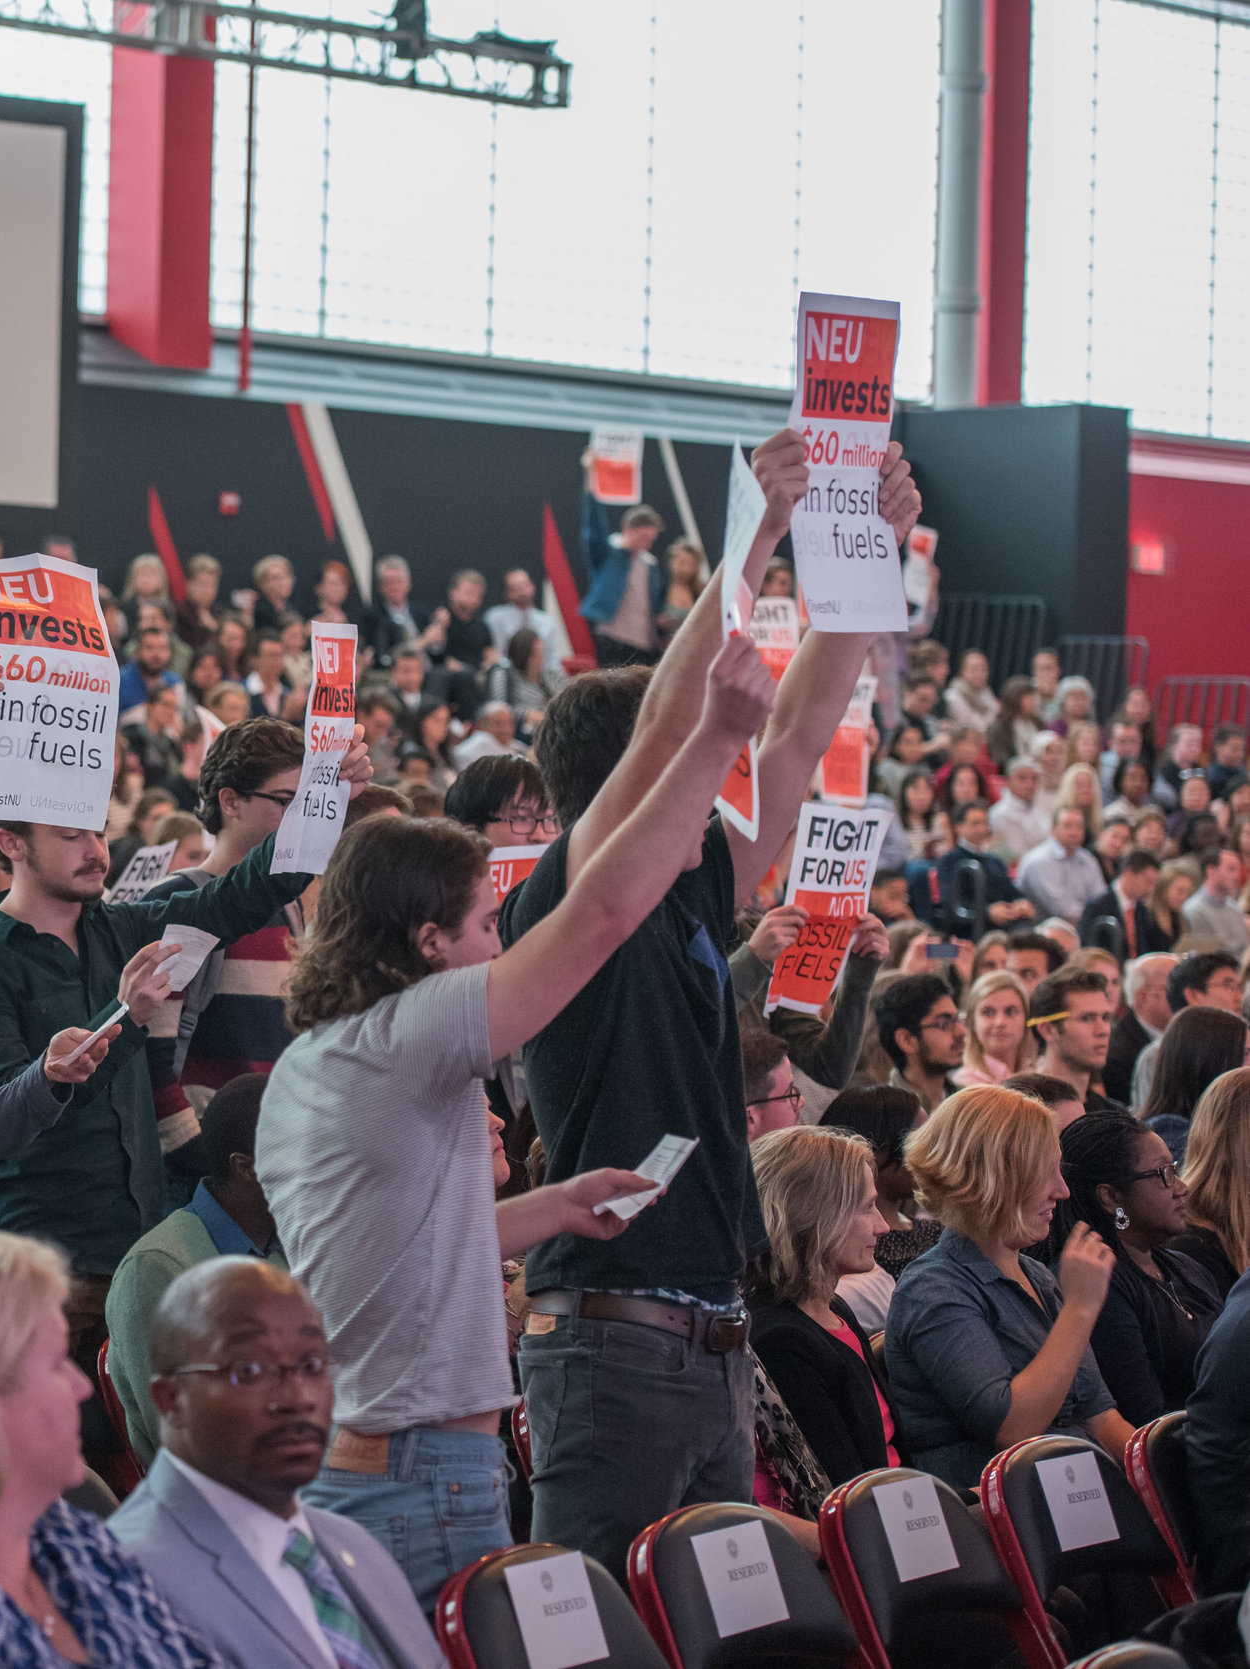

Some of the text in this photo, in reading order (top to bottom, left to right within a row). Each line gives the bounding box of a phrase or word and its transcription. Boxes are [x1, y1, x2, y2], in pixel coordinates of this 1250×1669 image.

[806, 317, 864, 364] NEU
[804, 367, 890, 416] invests
[803, 424, 886, 468] $60 million
[827, 479, 882, 516] fossil
[833, 523, 888, 559] fuels
[48, 669, 111, 695] million
[313, 681, 355, 714] invest
[0, 692, 107, 734] in fossil
[28, 731, 102, 770] fuels
[311, 722, 335, 756] $60
[807, 816, 879, 852] FIGHT
[490, 863, 513, 893] EU
[800, 857, 845, 886] FOR
[797, 922, 848, 951] OSSIL
[779, 953, 841, 982] FELS
[1067, 1488, 1101, 1505] RESERVED
[906, 1516, 940, 1532] RESERVED
[728, 1562, 768, 1582] RESERVED
[543, 1597, 587, 1617] RESERVED
